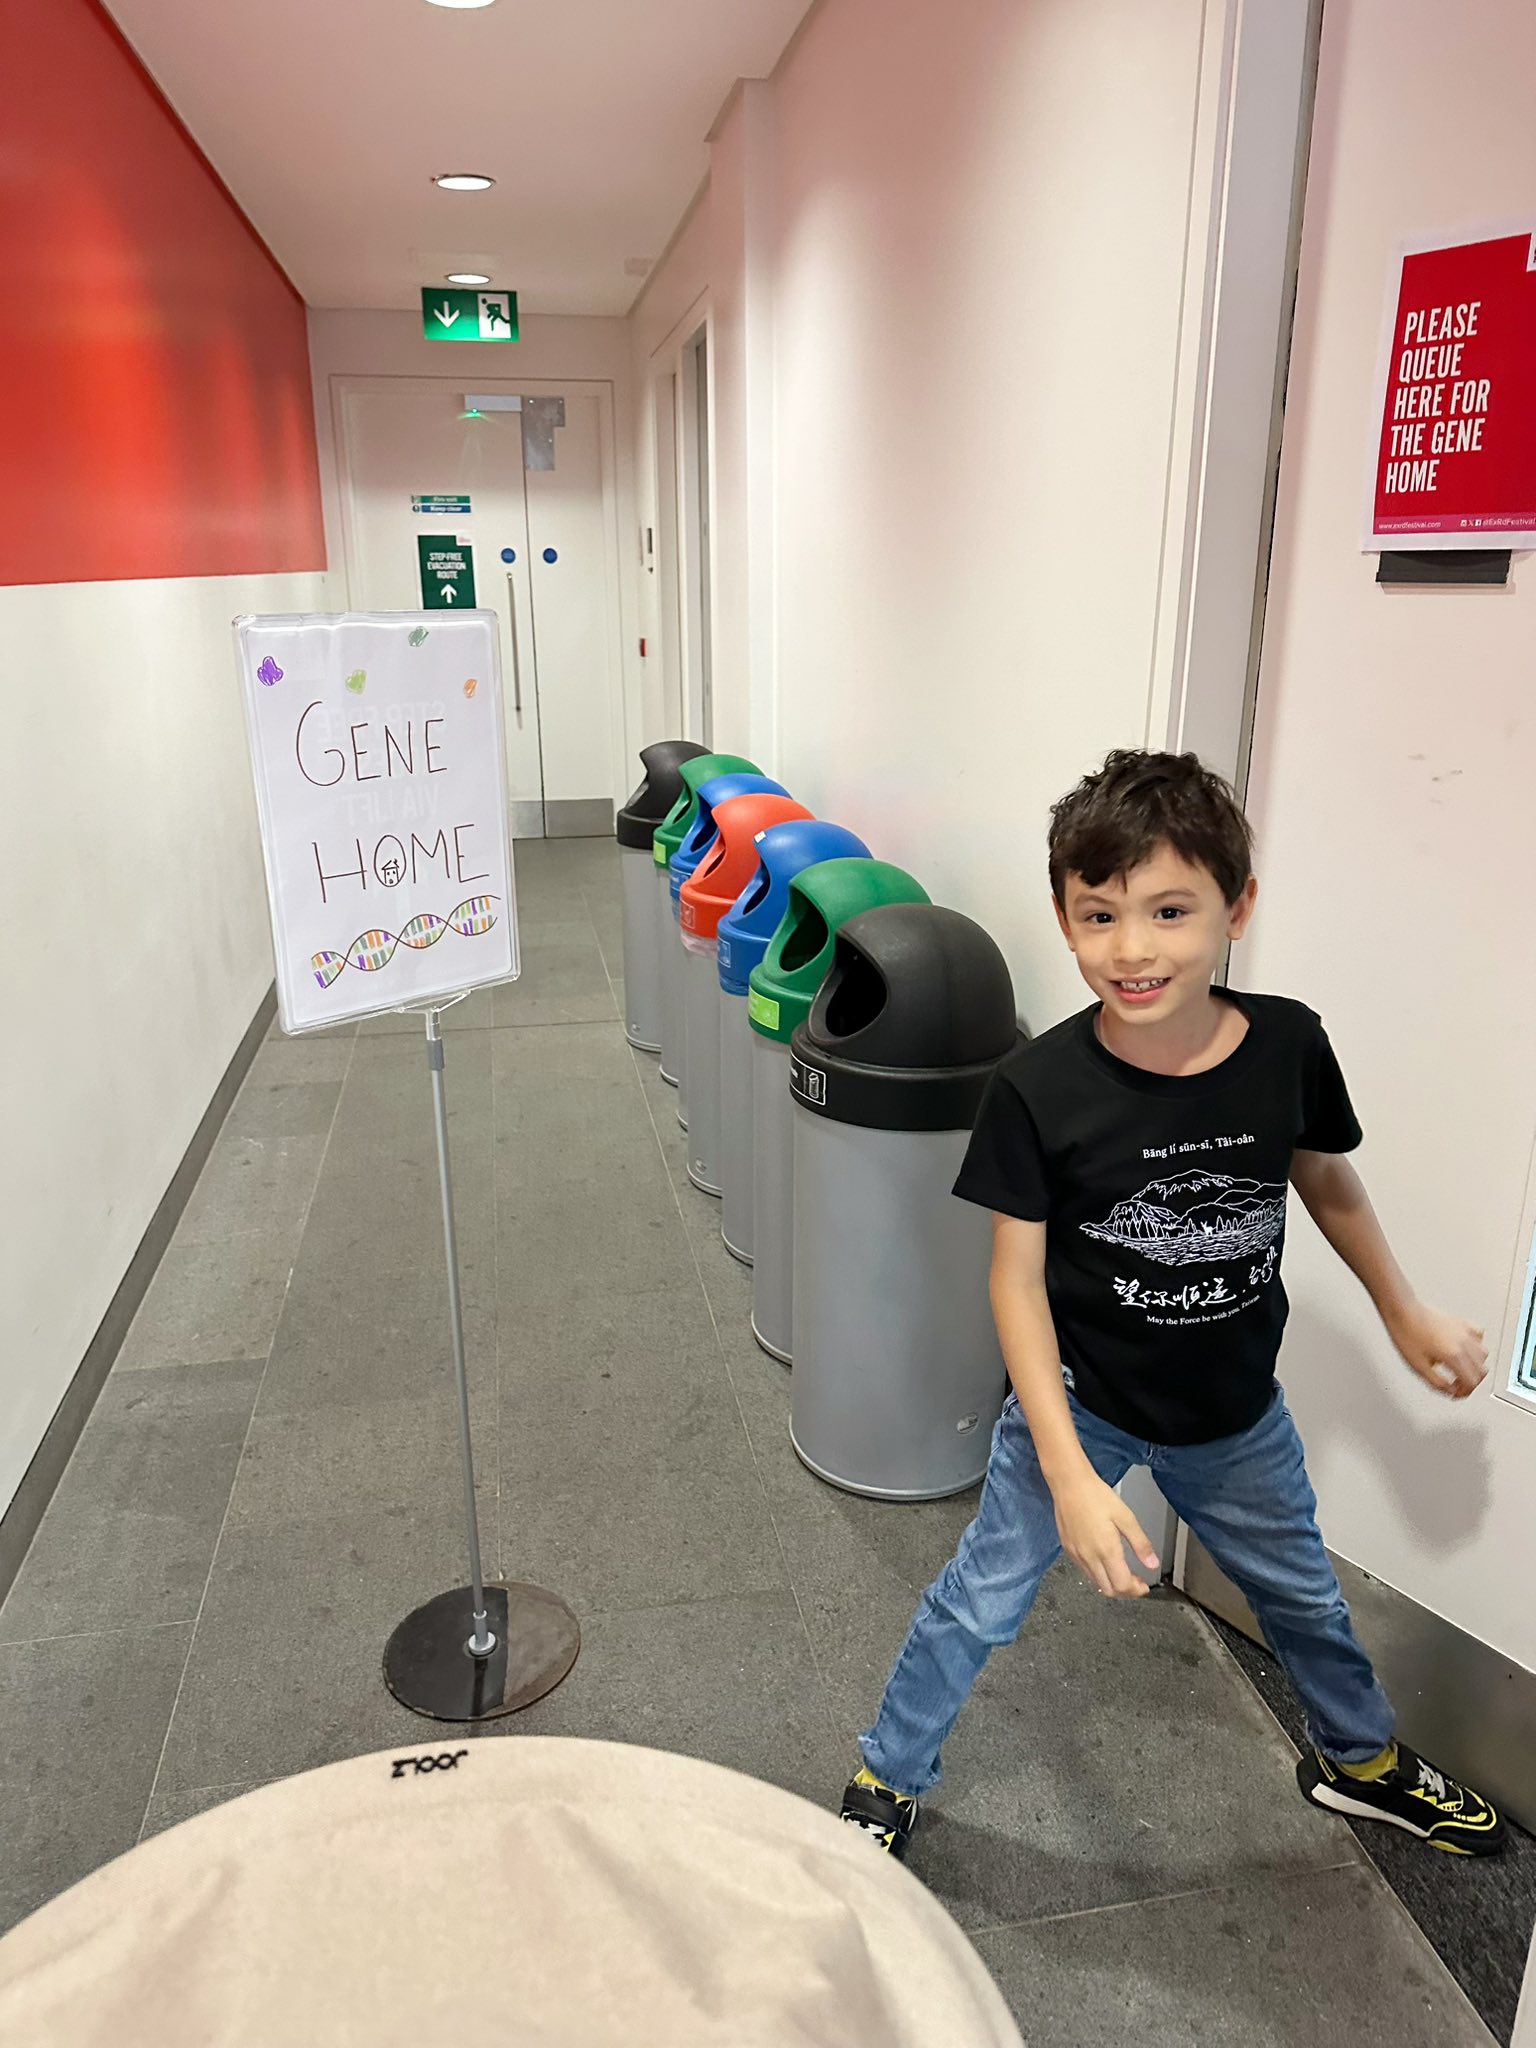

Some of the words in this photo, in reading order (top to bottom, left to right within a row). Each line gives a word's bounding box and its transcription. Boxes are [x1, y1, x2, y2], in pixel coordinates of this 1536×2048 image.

[1404, 302, 1481, 344] PLEASE
[1399, 344, 1465, 385] QUEUE
[1393, 385, 1443, 421] HERE
[1450, 379, 1491, 414] FOR
[1390, 423, 1426, 458] THE
[1430, 418, 1486, 454] GENE
[1384, 460, 1440, 494] HOME
[437, 571, 458, 579] ROUTE
[295, 700, 448, 787] GENE
[311, 823, 490, 904] HOME
[1146, 1315, 1165, 1326] May
[1166, 1317, 1178, 1325] the
[1179, 1316, 1200, 1326] Force
[1201, 1315, 1211, 1323] be
[1212, 1311, 1228, 1321] with
[1241, 1294, 1261, 1310] Taiwan
